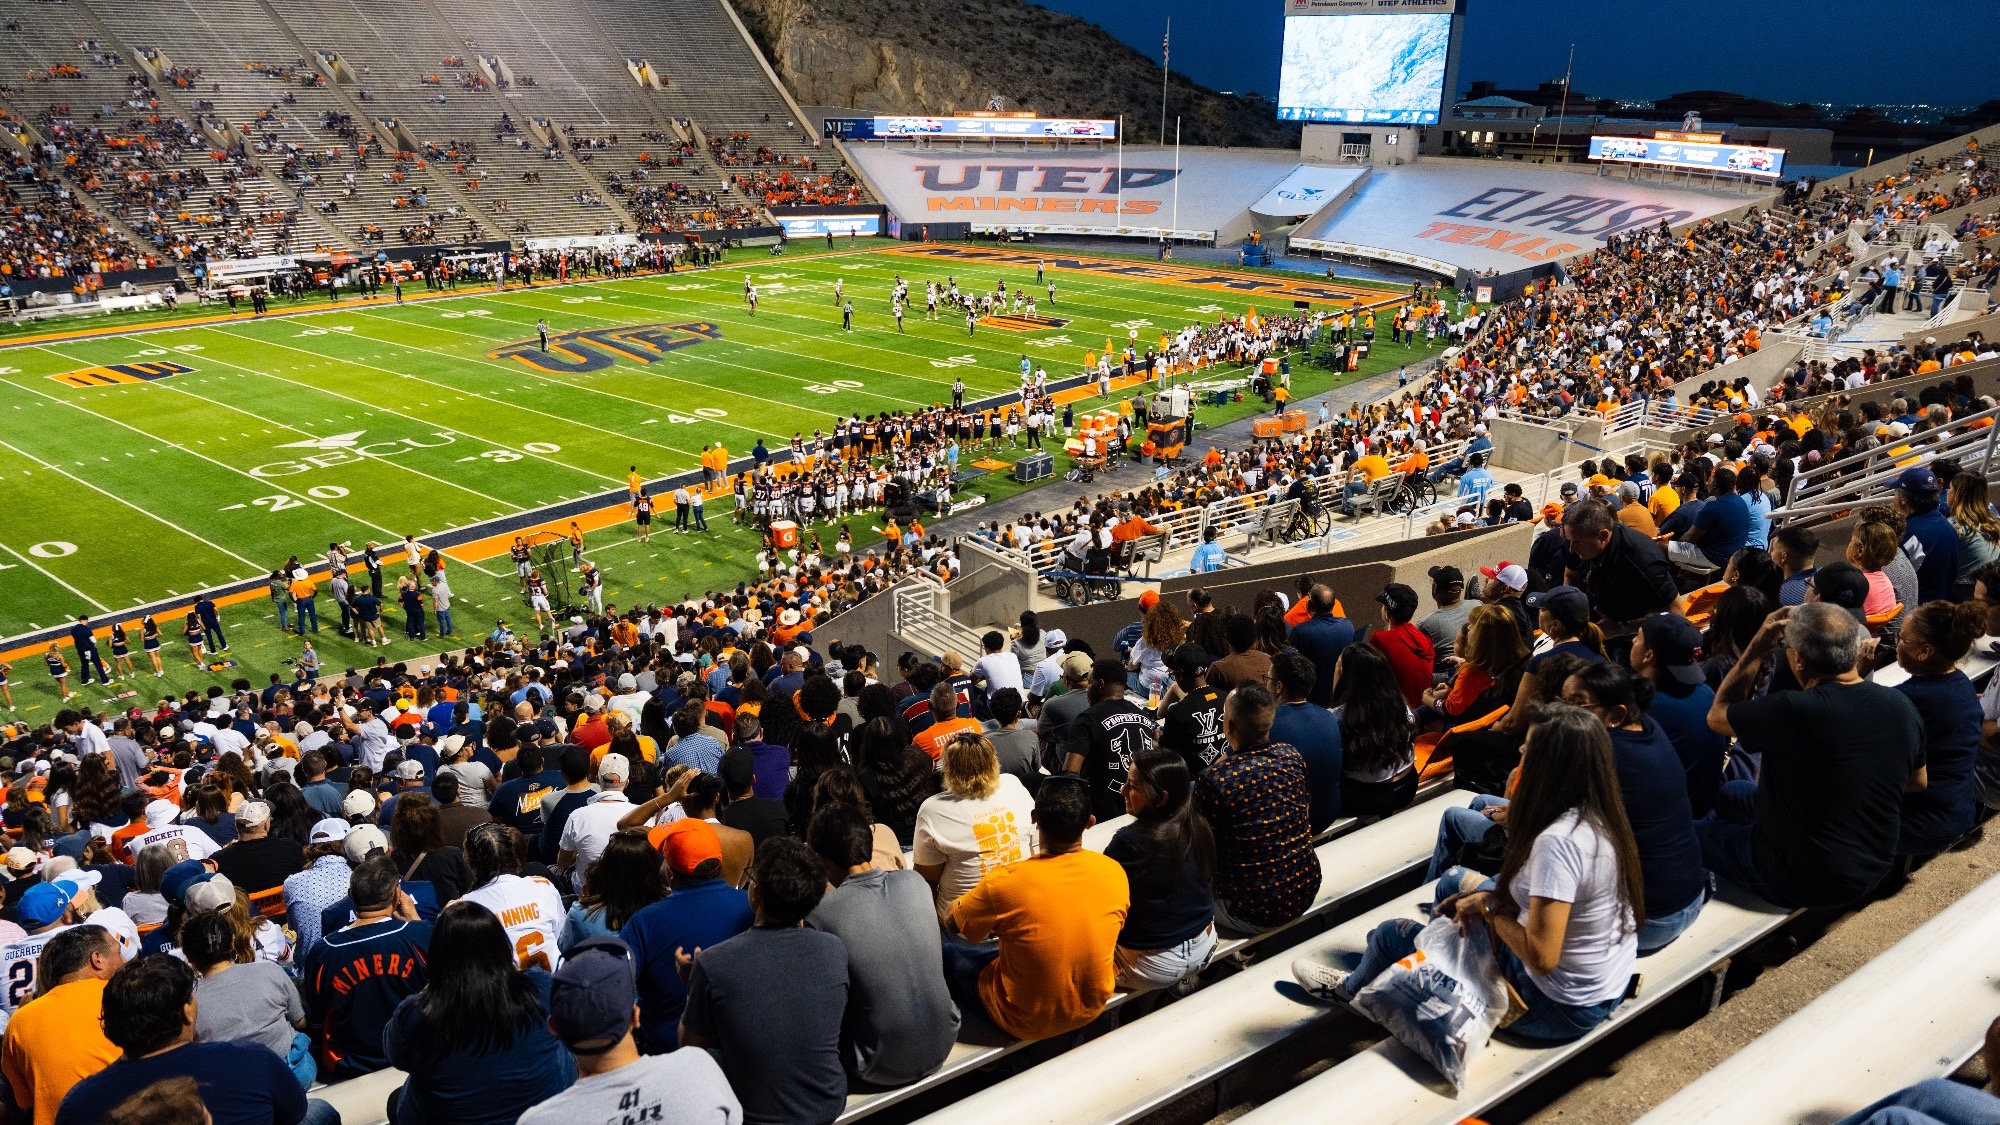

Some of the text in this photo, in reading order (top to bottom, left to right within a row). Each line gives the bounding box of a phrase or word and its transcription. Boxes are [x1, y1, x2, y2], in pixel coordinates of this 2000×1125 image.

[913, 164, 1183, 193] UTEP
[926, 197, 1163, 214] MINERS
[1435, 187, 1696, 241] EL PASO
[1414, 221, 1582, 261] TEXAS
[485, 320, 725, 374] UTEP
[929, 355, 977, 368] 40
[803, 380, 864, 394] 50
[667, 408, 728, 424] 40
[912, 424, 921, 432] 70
[249, 431, 456, 477] GECU
[480, 442, 561, 463] 30
[252, 486, 350, 512] 20
[755, 490, 766, 500] 37
[770, 490, 780, 499] 40
[1642, 484, 1653, 503] 71
[783, 531, 793, 542] G
[1104, 715, 1141, 730] PROPERTY
[143, 828, 185, 846] HOCKETT
[166, 838, 190, 862] 8
[8, 959, 38, 1009] 2
[331, 953, 416, 996] MINERS
[618, 1088, 641, 1111] 41
